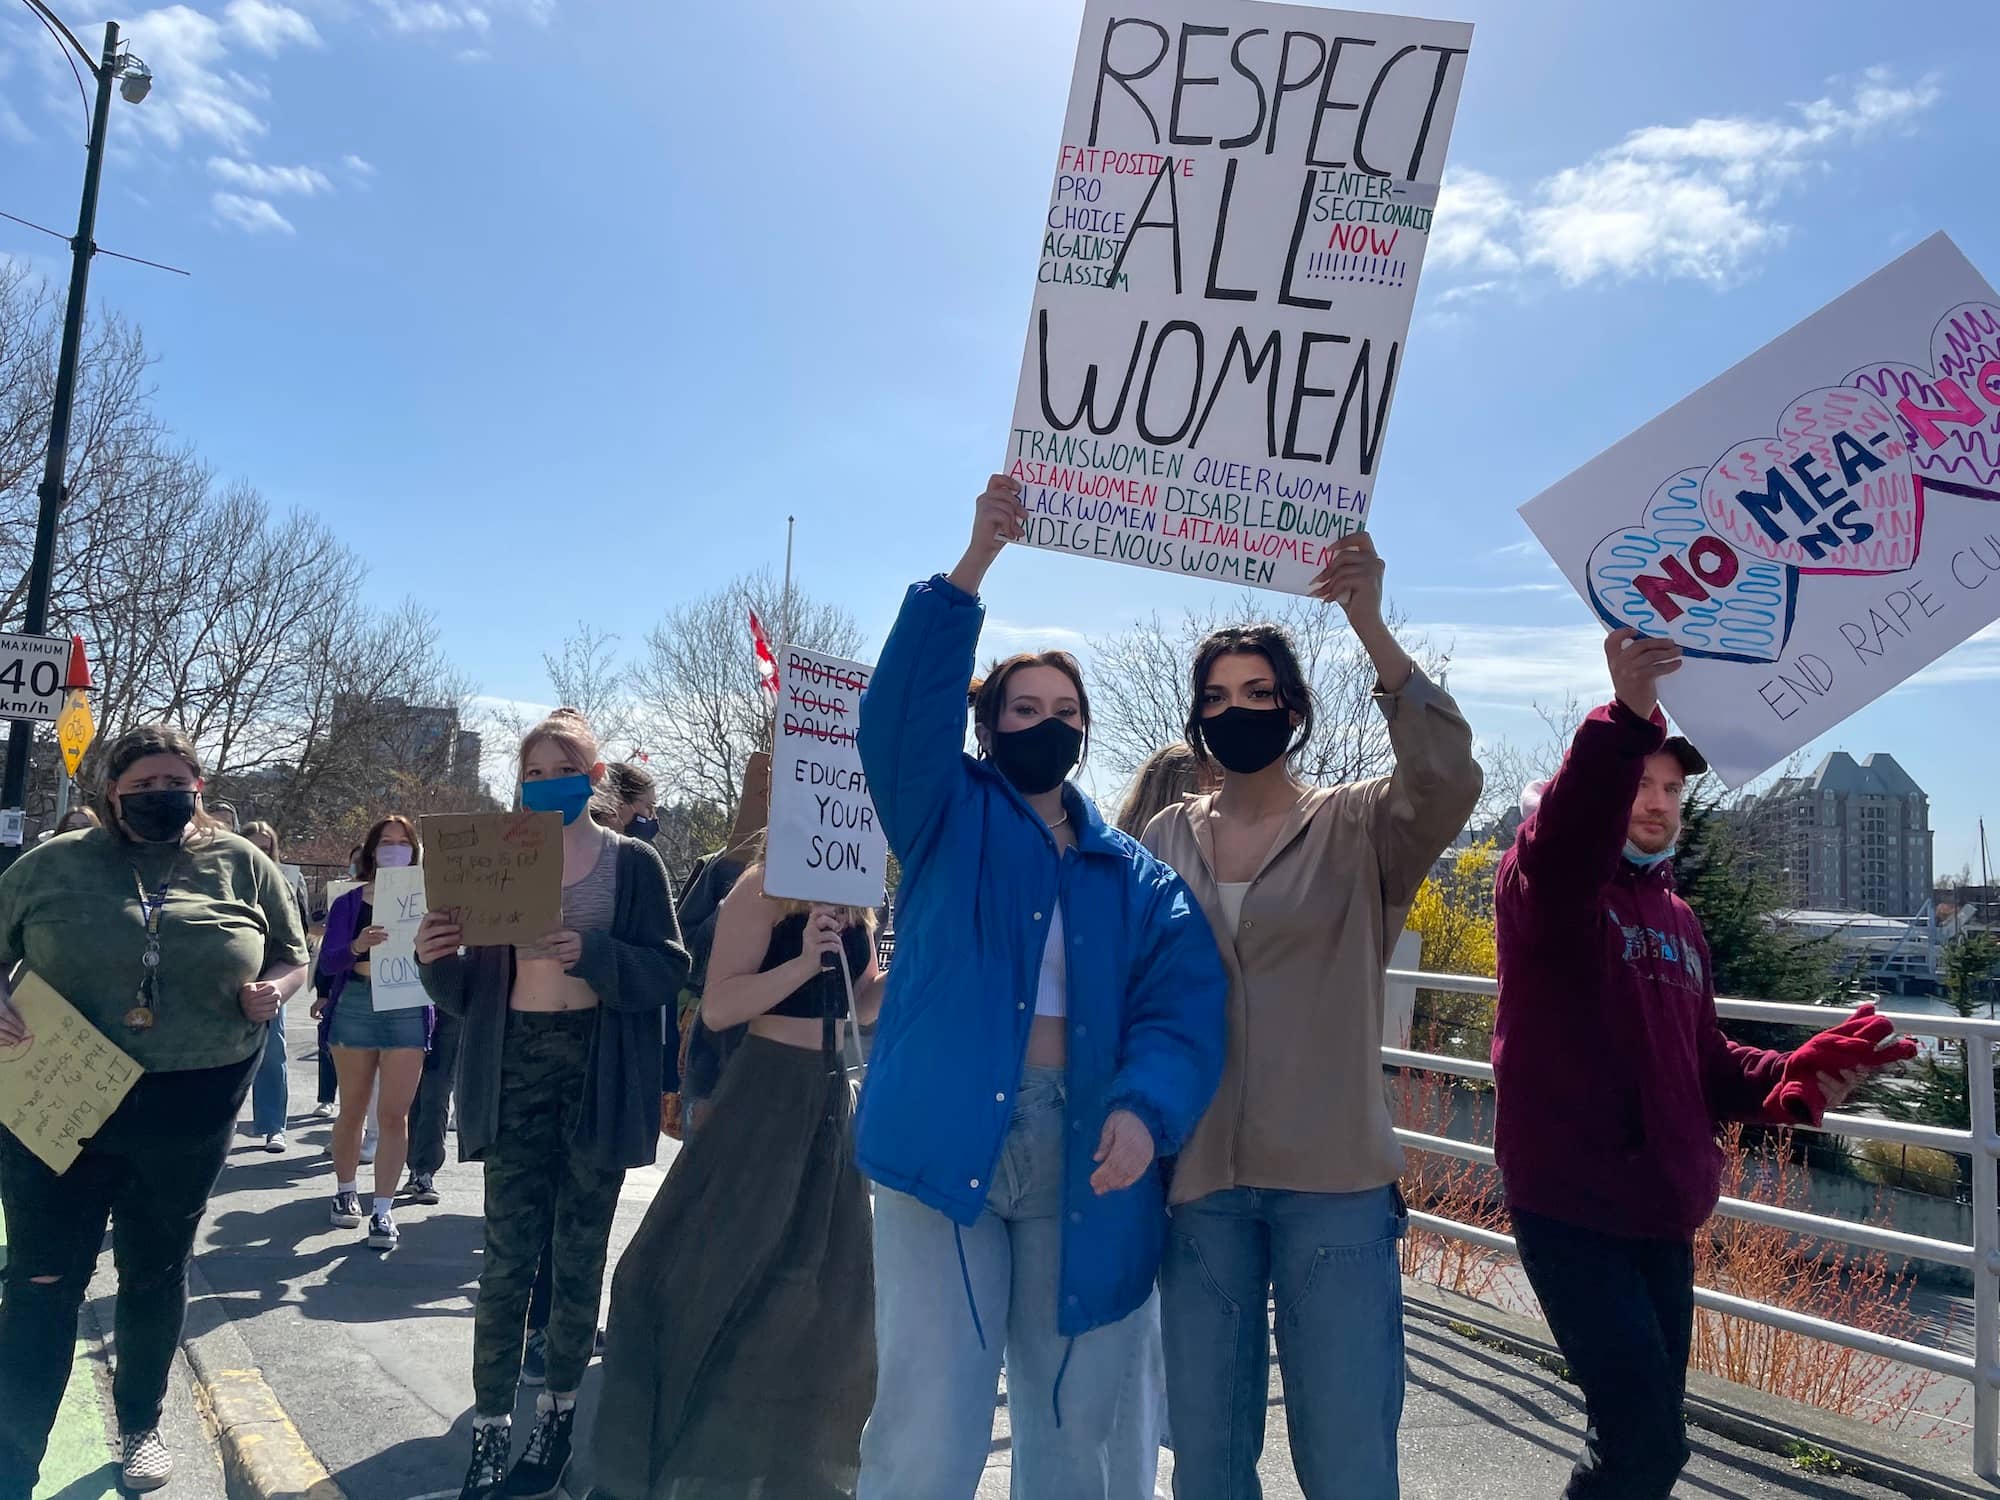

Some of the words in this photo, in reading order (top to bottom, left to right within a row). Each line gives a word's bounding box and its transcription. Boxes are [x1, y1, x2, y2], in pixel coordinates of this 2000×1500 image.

[1088, 17, 1469, 181] RESPECT
[1060, 145, 1100, 172] FAT
[1058, 175, 1101, 202] PRO
[1320, 171, 1406, 200] INTER-
[1048, 205, 1126, 234] CHOICE
[1107, 156, 1333, 310] ALL
[1043, 231, 1126, 264] AGAINST
[1328, 222, 1399, 256] NOW
[1039, 309, 1398, 475] WOMEN
[1796, 500, 1875, 560] NS
[1000, 517, 1173, 567] NDIGENOUS
[1180, 548, 1276, 585] WOMEN
[1633, 535, 1740, 623] NO
[1757, 653, 1834, 720] END
[1838, 579, 1945, 666] RAPE
[1951, 533, 2000, 590] CU
[1, 640, 63, 656] MAXIMUM
[0, 658, 59, 697] 40
[788, 652, 869, 696] PROTECT
[0, 698, 48, 714] km/h
[788, 684, 846, 720] YOUR
[784, 713, 860, 750] DAUGH
[814, 794, 873, 834] YOUR
[806, 835, 867, 874] SON.
[396, 892, 424, 918] YE
